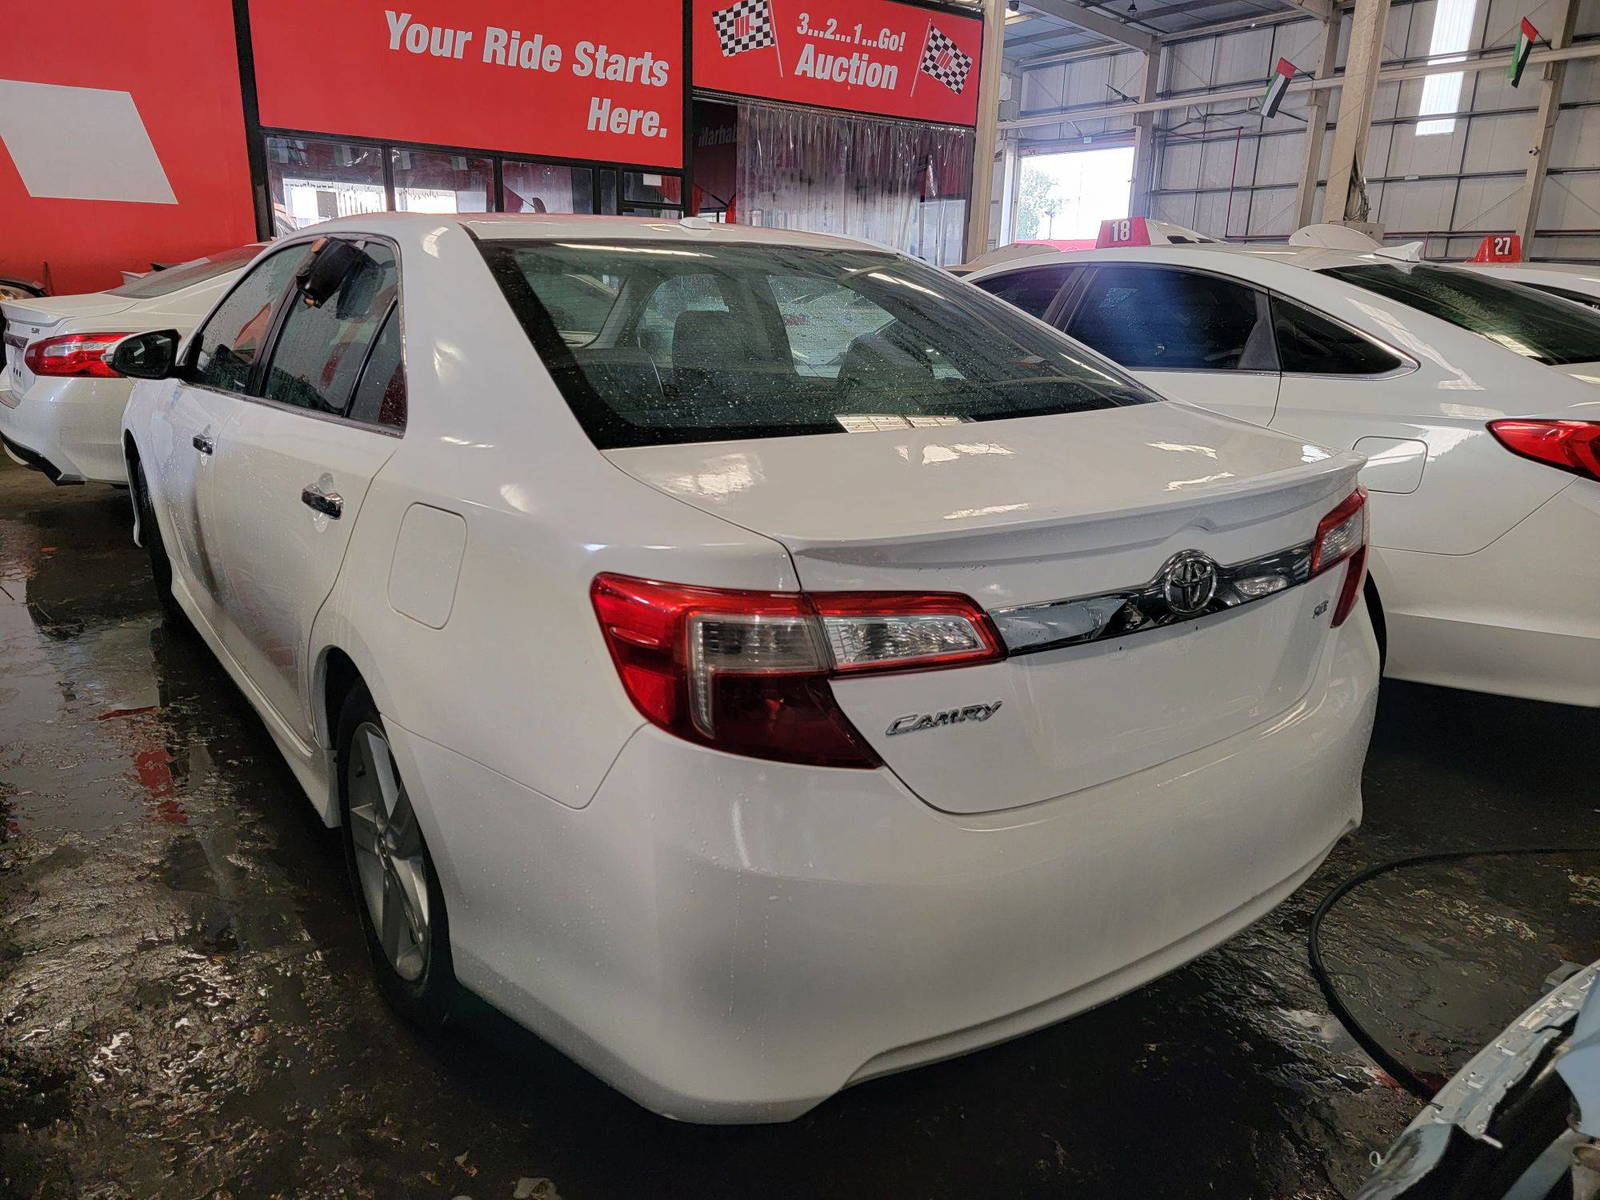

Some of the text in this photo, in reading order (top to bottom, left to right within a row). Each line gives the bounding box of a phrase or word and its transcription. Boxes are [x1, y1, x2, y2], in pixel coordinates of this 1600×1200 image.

[384, 10, 669, 87] Your Ride Starts
[794, 43, 899, 90] Auction
[587, 97, 668, 138] Here.
[1112, 220, 1130, 241] 18
[1494, 237, 1511, 255] 27
[886, 700, 1003, 736] CAMRY
